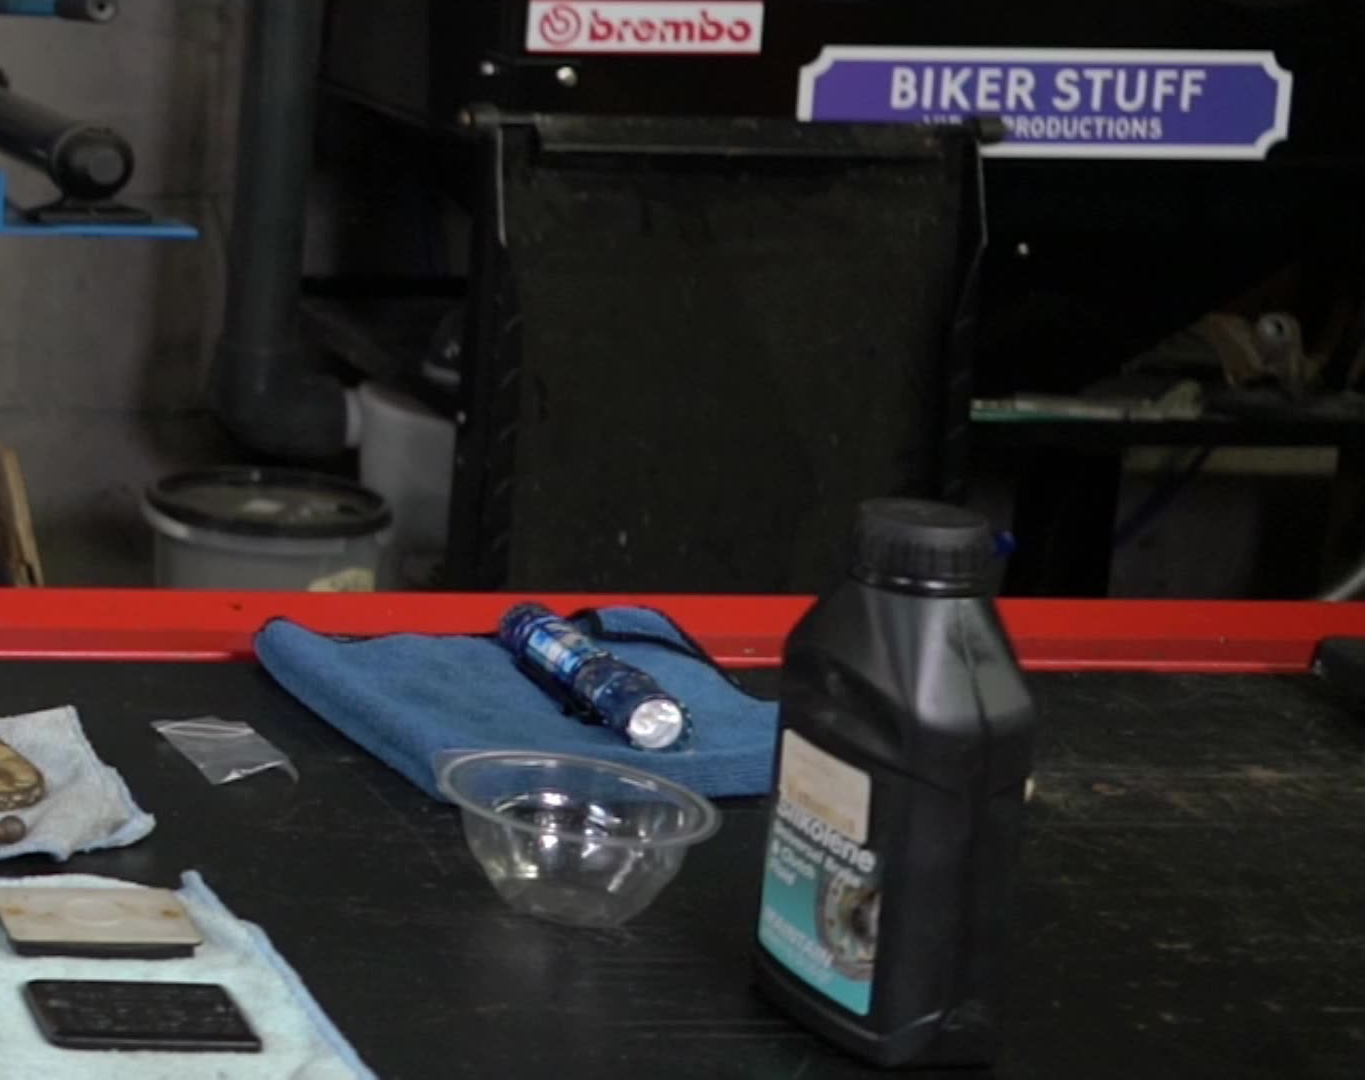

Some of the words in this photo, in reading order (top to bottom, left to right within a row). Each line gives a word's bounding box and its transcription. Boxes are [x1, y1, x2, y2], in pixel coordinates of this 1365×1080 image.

[588, 8, 752, 43] brembo
[890, 66, 1037, 111] BIKER
[1052, 68, 1206, 113] STUFF
